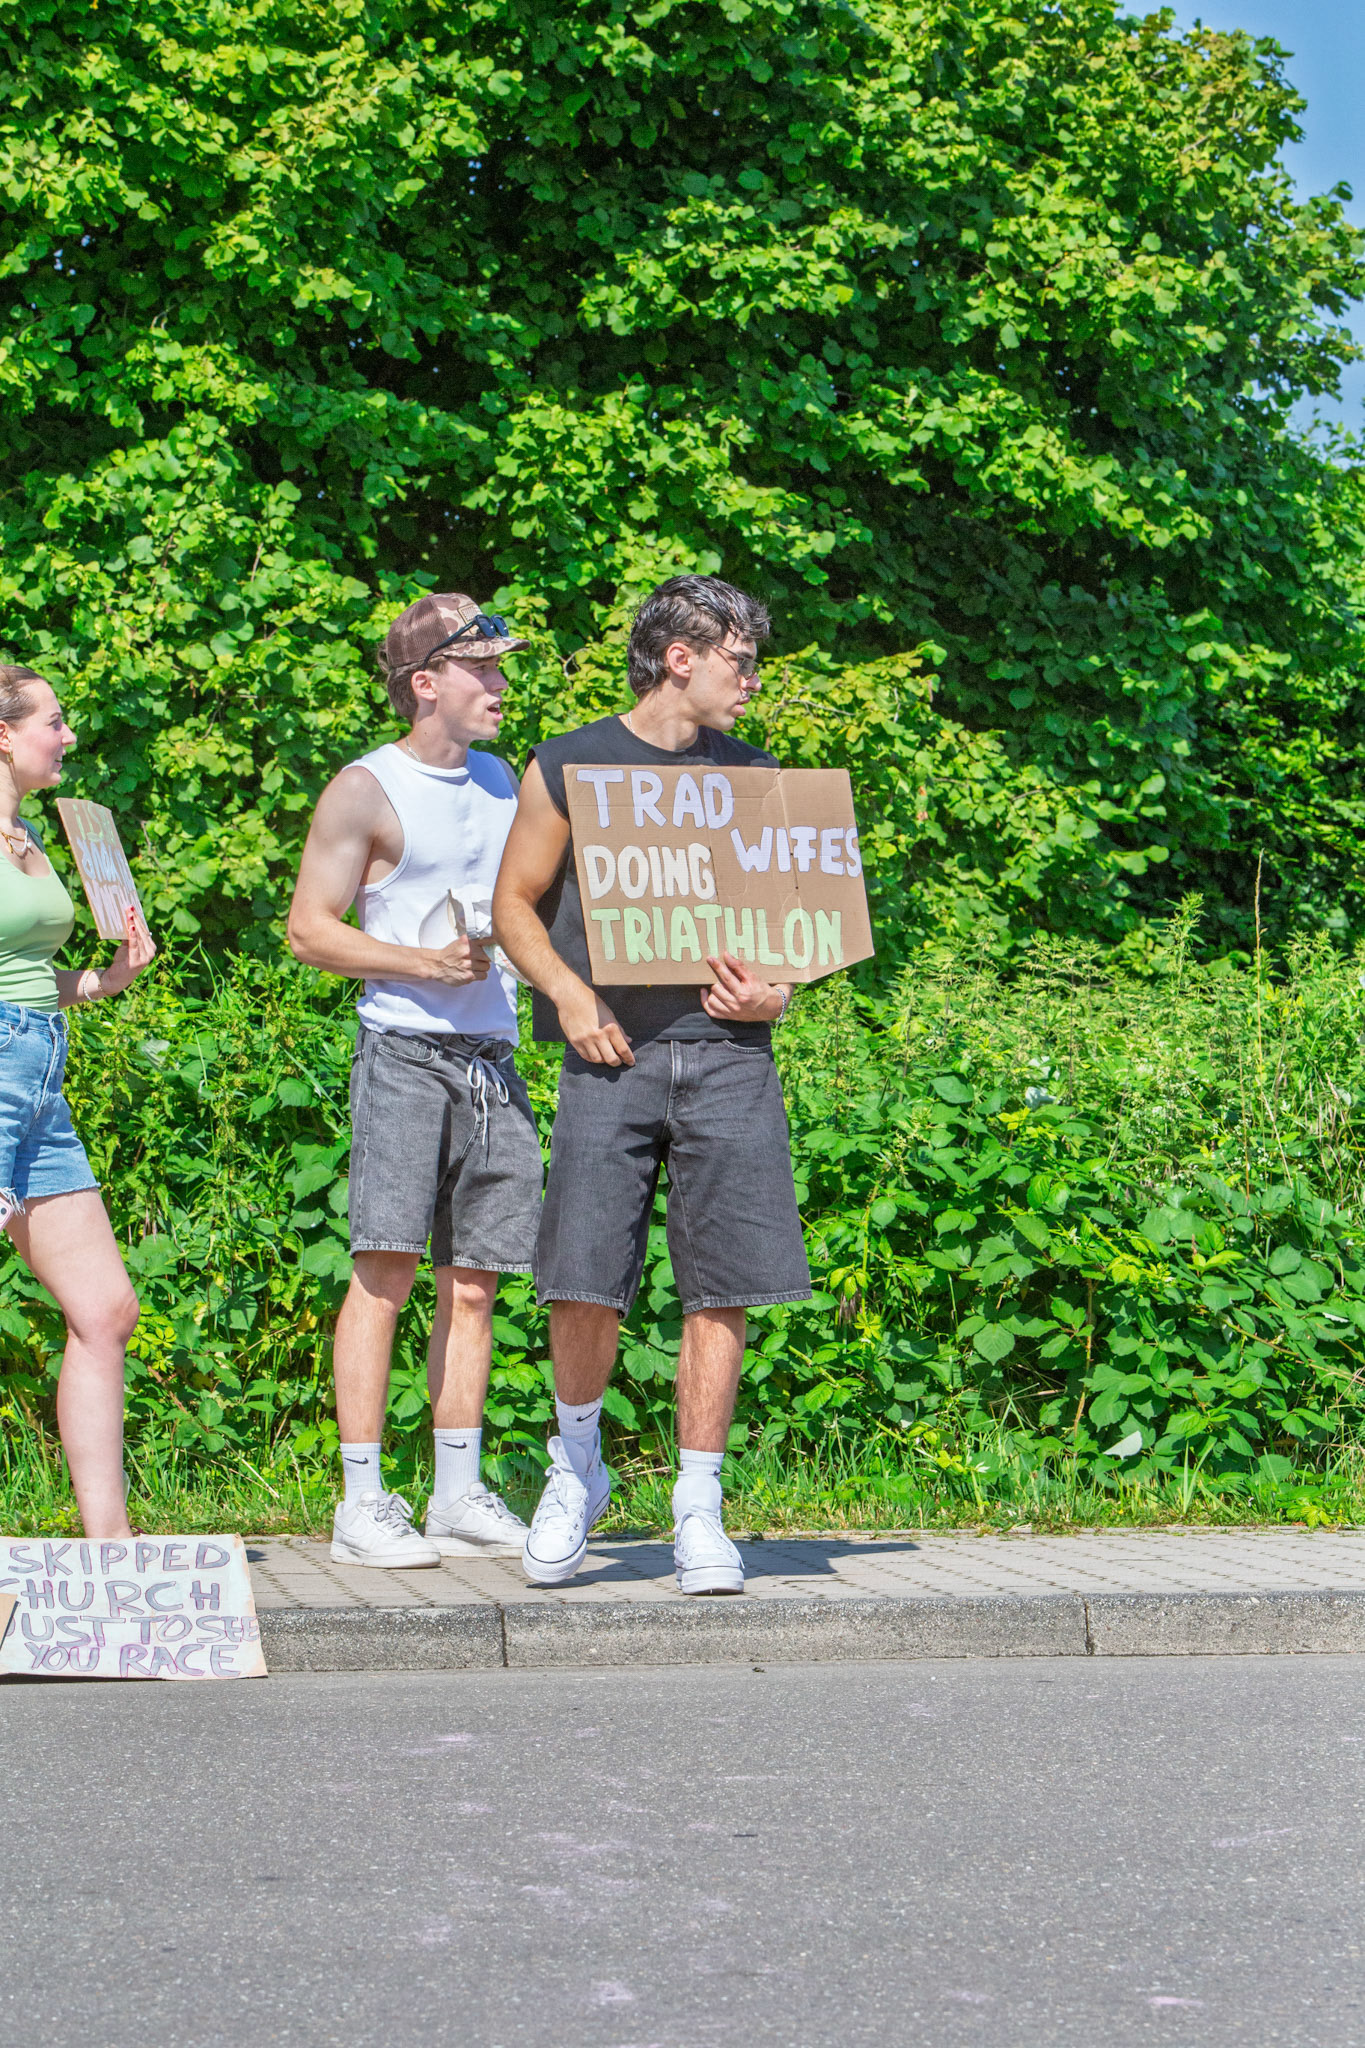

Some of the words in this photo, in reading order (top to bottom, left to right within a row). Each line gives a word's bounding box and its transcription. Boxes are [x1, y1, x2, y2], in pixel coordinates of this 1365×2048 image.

[576, 769, 734, 829] TRAD
[583, 842, 718, 900] DOING
[730, 825, 863, 878] WIFES
[590, 904, 845, 969] TRIATHLON
[8, 1542, 231, 1577] SKIPPED
[6, 1613, 126, 1647] UST
[24, 1641, 100, 1672] YOU
[119, 1643, 241, 1678] RACE
